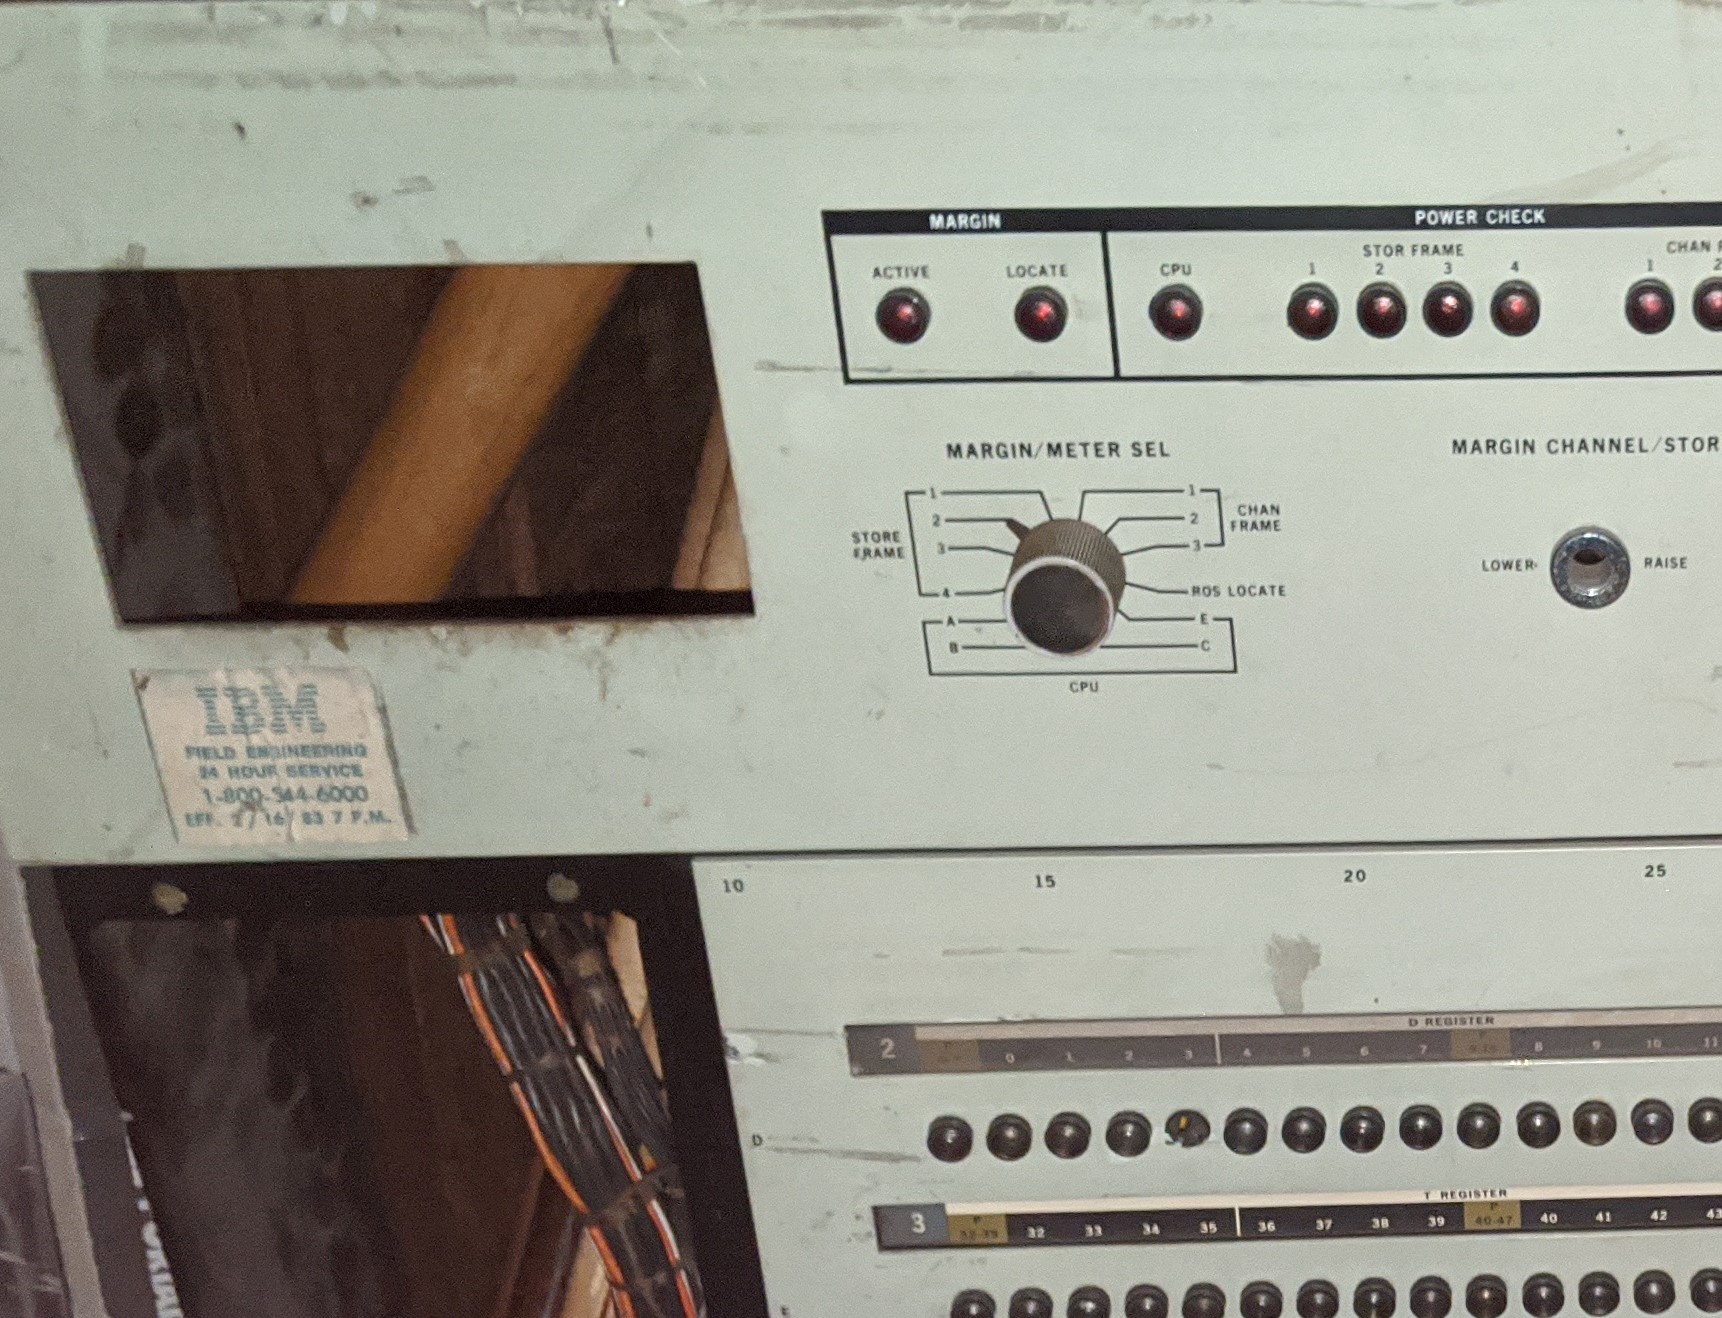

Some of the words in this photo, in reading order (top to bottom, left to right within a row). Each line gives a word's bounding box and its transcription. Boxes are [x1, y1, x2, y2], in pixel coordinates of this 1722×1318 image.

[929, 213, 1001, 231] MARGIN
[1414, 210, 1478, 227] POWER
[1487, 209, 1546, 226] CHECK
[1362, 243, 1405, 258] STOR
[1411, 242, 1465, 258] FRAME
[1666, 239, 1711, 255] CHAN
[1006, 263, 1069, 279] LOCATE
[1159, 262, 1192, 277] CPU
[1374, 262, 1385, 275] 2
[1443, 262, 1453, 275] 3
[1510, 260, 1520, 274] 4
[1712, 257, 1722, 271] 2
[872, 265, 930, 279] ACTIVE
[946, 441, 1121, 461] MARGIN/METER
[1130, 440, 1171, 459] SEL
[1451, 437, 1536, 456] MARGIN
[1546, 435, 1720, 454] CHANNEL/STOR
[1237, 503, 1281, 517] CHAN
[932, 514, 941, 527] 2
[1189, 512, 1199, 525] 2
[1230, 520, 1282, 533] FRAME
[851, 531, 901, 544] STORE
[937, 542, 946, 555] 3
[1192, 539, 1201, 552] 3
[852, 546, 905, 560] FRAME
[1481, 558, 1534, 572] LOWER
[1644, 556, 1688, 570] RAISE
[941, 587, 951, 600] 4
[1190, 584, 1223, 598] ROS
[1227, 584, 1287, 598] LOCATE
[946, 615, 956, 628] A
[1200, 613, 1209, 626] E
[949, 641, 959, 654] B
[1200, 639, 1211, 653] C
[1069, 681, 1100, 694] CPU
[194, 683, 327, 736] IBM
[184, 744, 236, 760] FIELD
[245, 742, 368, 760] ENGINEERING
[227, 764, 278, 780] HOUR
[285, 763, 364, 779] SERVICE
[722, 877, 744, 894] 10
[1034, 874, 1056, 890] 15
[1343, 868, 1368, 884] 20
[1644, 864, 1668, 879] 25
[1407, 1017, 1420, 1028] D
[1424, 1015, 1496, 1028] REGISTER
[879, 1038, 897, 1061] 2
[751, 1135, 763, 1146] D
[1439, 1188, 1510, 1200] REGISTER
[910, 1212, 927, 1234] 3
[1026, 1226, 1046, 1239] 32
[1142, 1224, 1161, 1237] 34
[1200, 1221, 1219, 1234] 35
[1314, 1218, 1334, 1232] 37
[1370, 1216, 1391, 1230] 38
[1426, 1215, 1446, 1228] 39
[1539, 1212, 1559, 1225] 40
[1594, 1211, 1613, 1224] 41
[1649, 1210, 1669, 1222] 42
